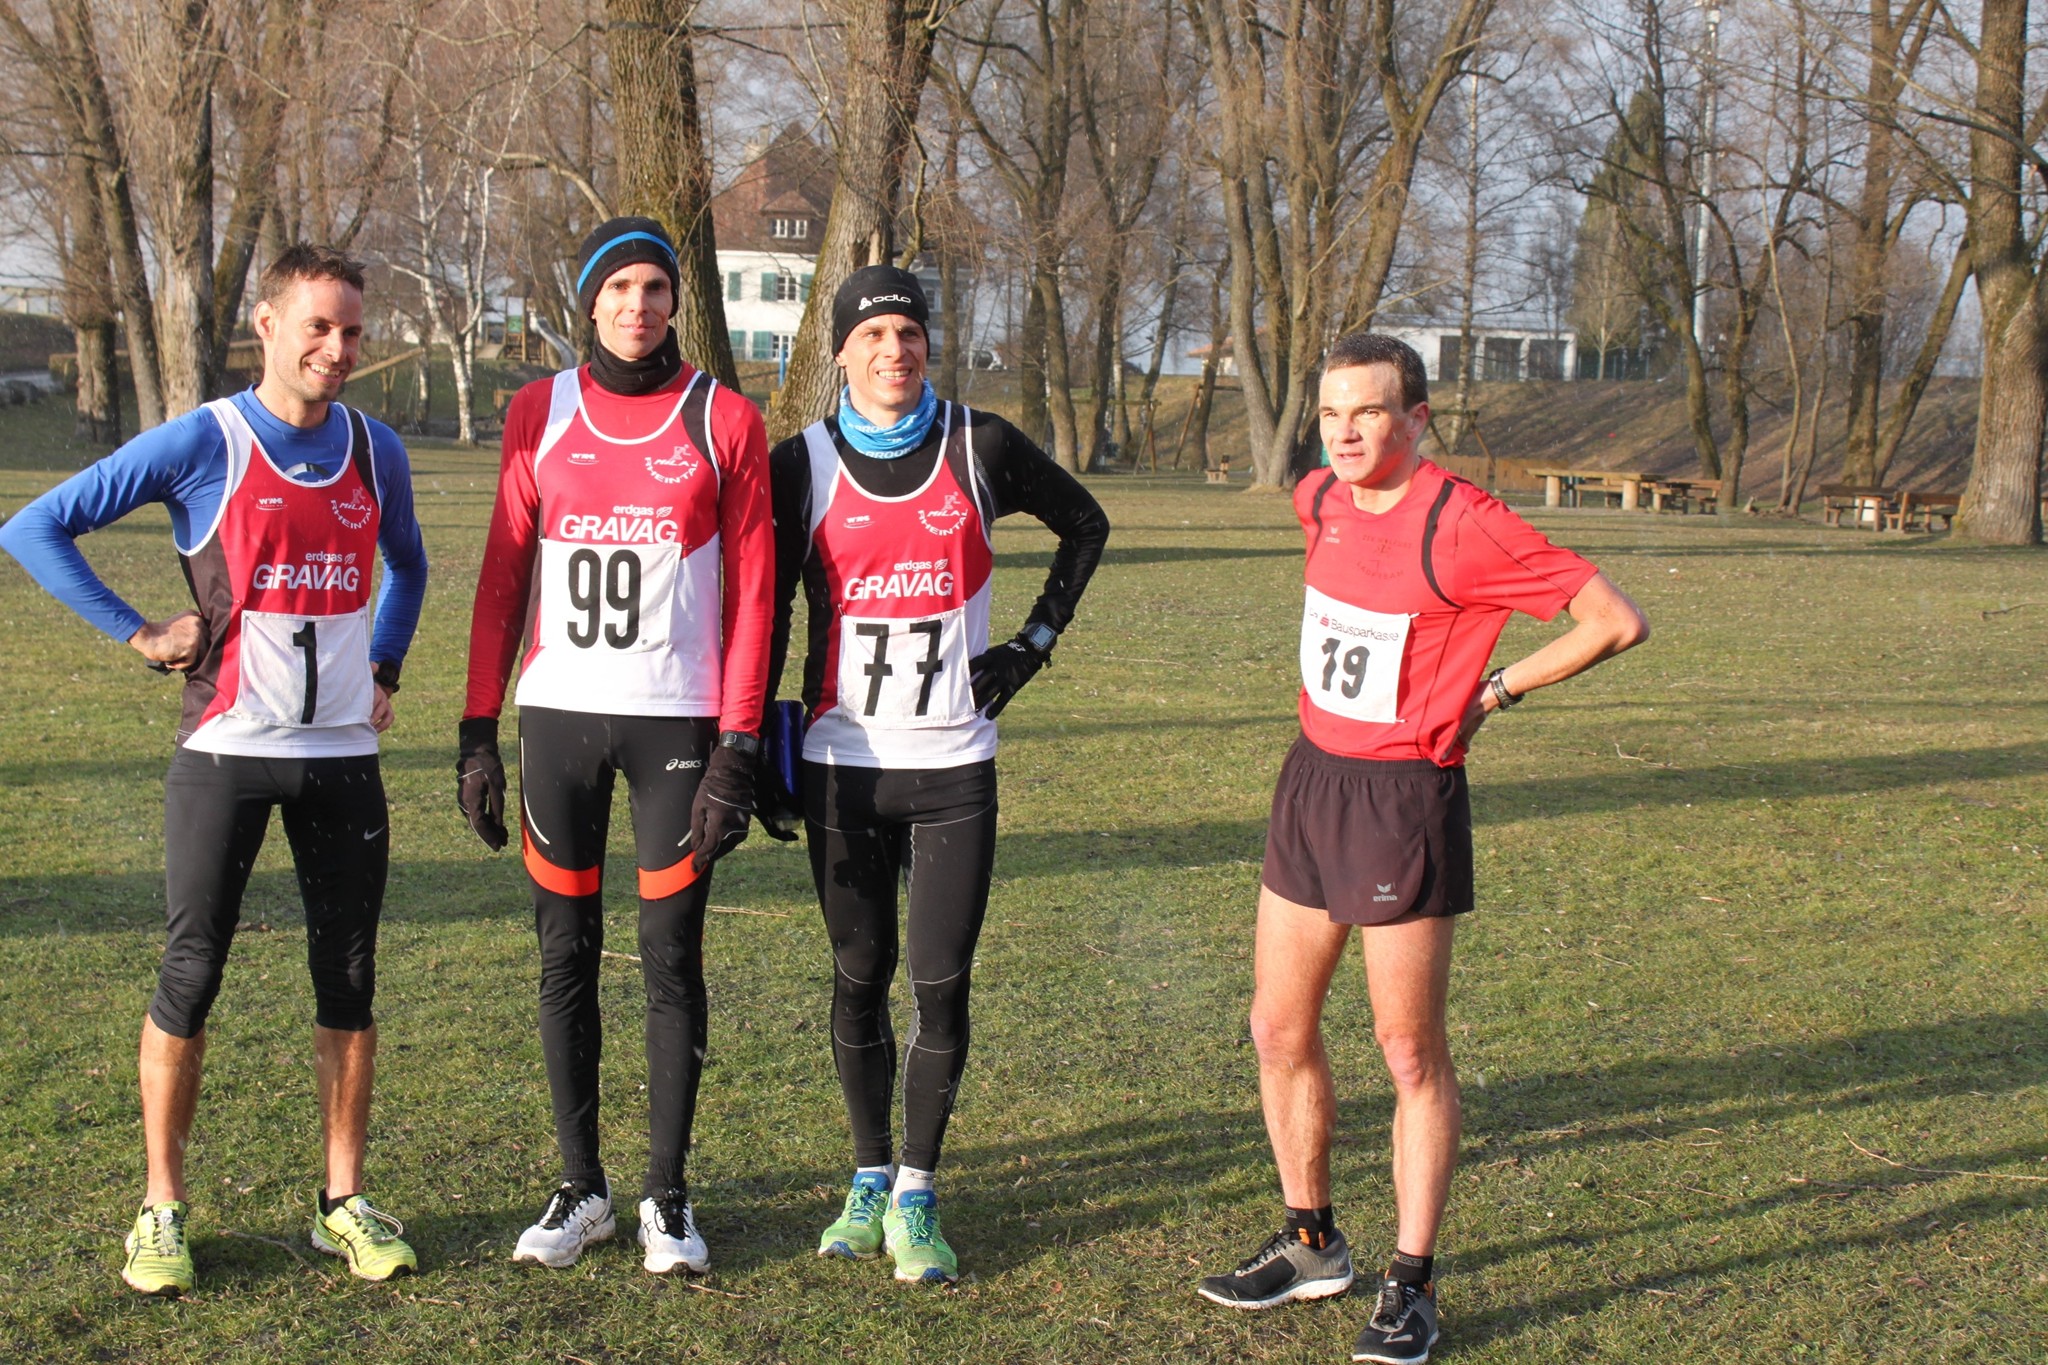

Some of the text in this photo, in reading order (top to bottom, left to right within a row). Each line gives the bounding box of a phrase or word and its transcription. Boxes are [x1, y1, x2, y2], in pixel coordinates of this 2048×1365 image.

[872, 294, 911, 303] odlo
[644, 456, 699, 484] RHEINTAL
[330, 499, 372, 530] RHEINTAL
[339, 502, 366, 511] MILA
[612, 504, 654, 517] erdgas
[926, 509, 960, 518] MILA
[559, 514, 678, 544] GRAVAG
[917, 508, 969, 536] RHEINTAL
[305, 551, 343, 563] erdgas
[893, 559, 932, 572] erdgas
[252, 563, 360, 592] GRAVAG
[844, 571, 954, 601] GRAVAG
[567, 548, 642, 650] 99
[292, 621, 319, 725] 1
[855, 618, 943, 717] 77
[1321, 637, 1371, 700] 19
[678, 759, 702, 769] asics
[1372, 894, 1398, 902] erima
